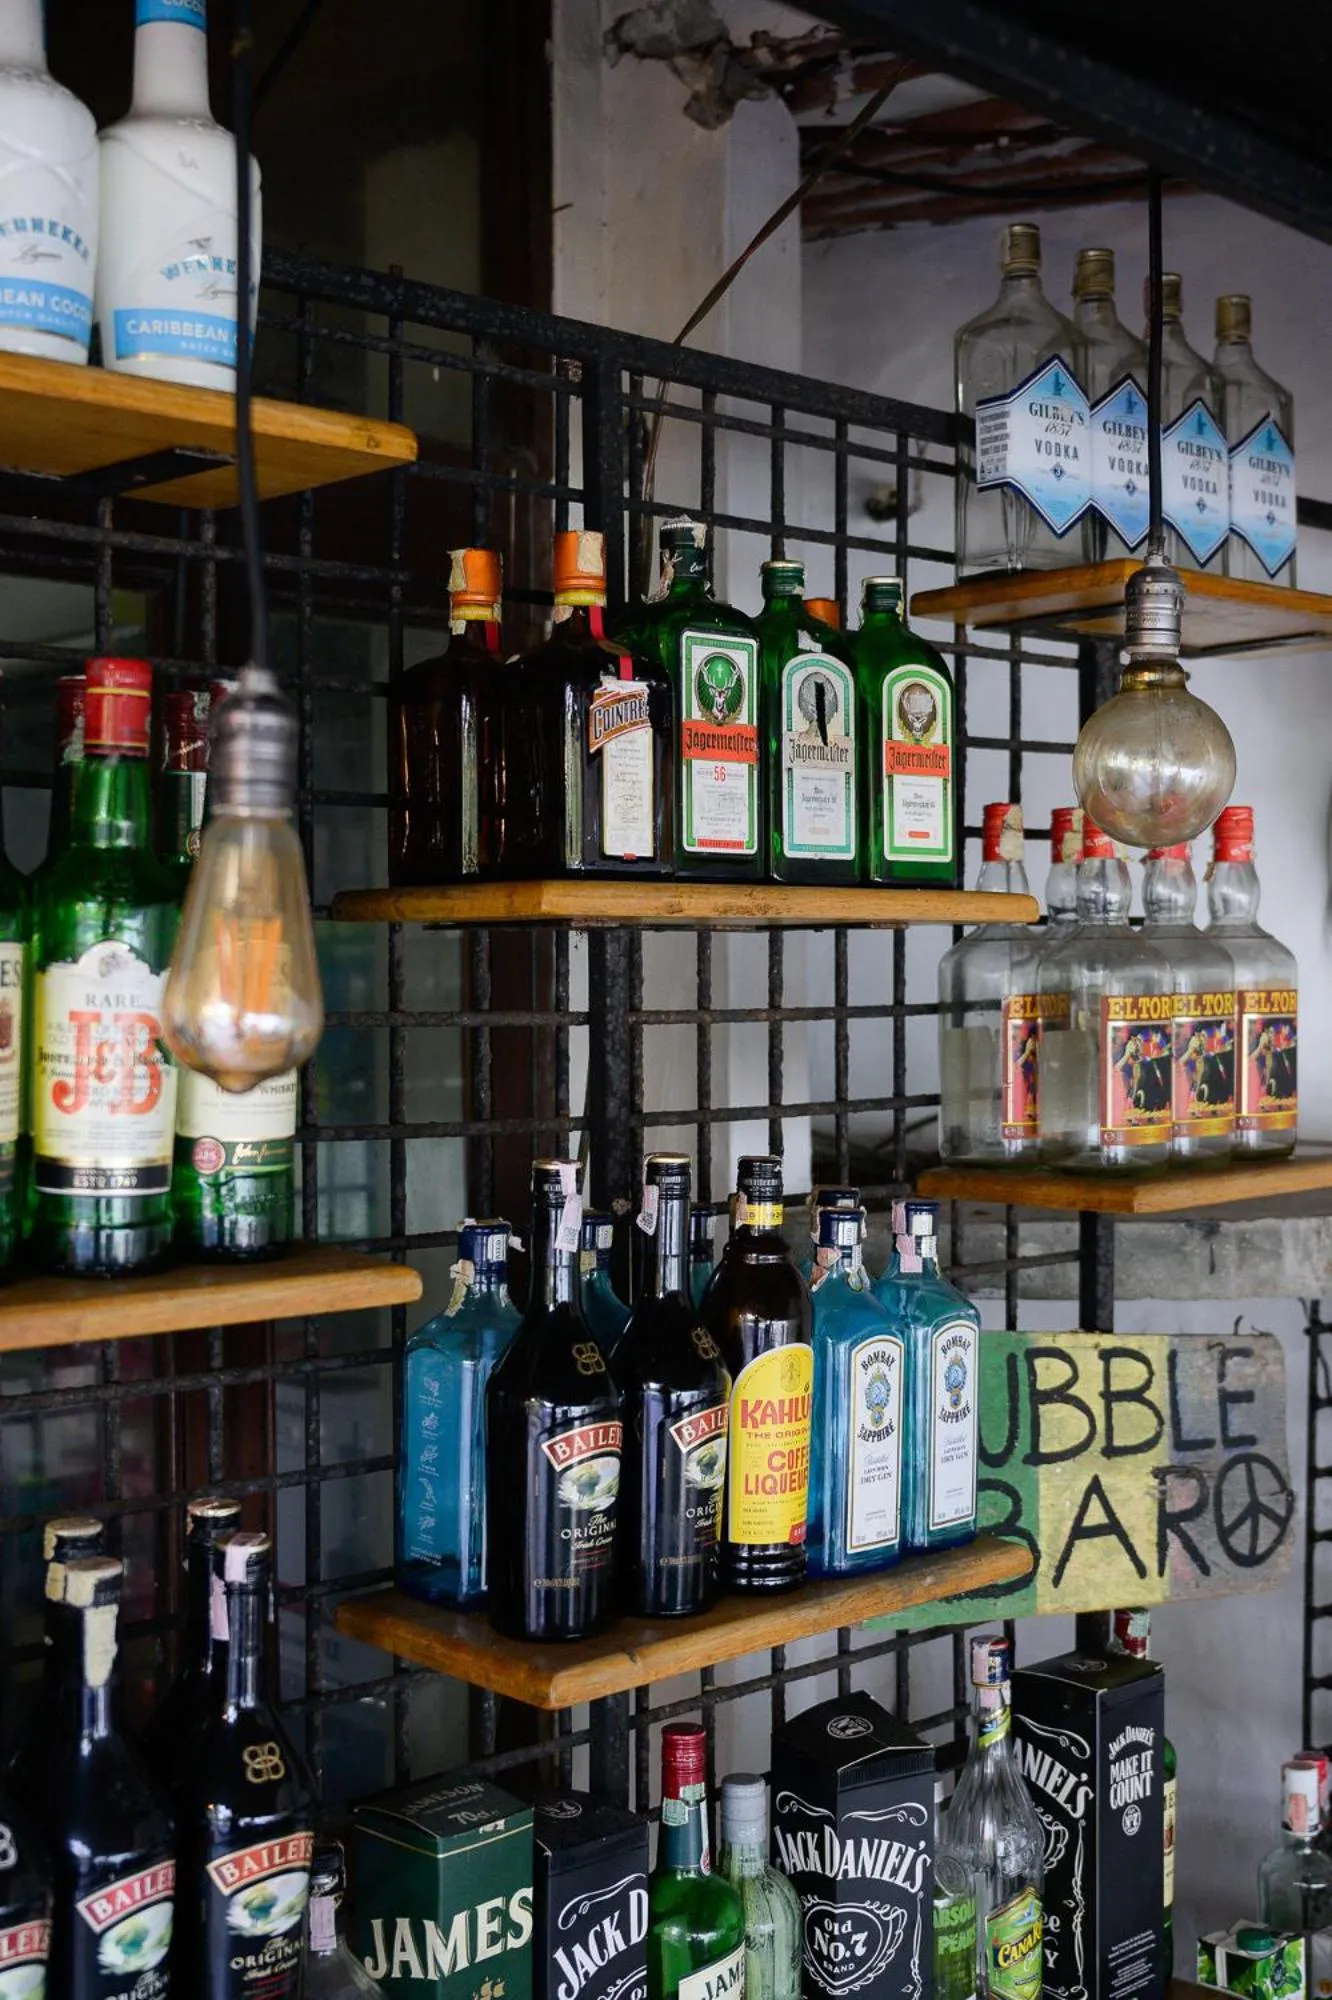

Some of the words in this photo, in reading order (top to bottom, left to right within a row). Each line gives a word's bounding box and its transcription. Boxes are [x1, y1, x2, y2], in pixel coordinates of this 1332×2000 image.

[0, 287, 45, 308] EAN
[126, 319, 229, 342] CARIBBEAN
[1102, 419, 1146, 441] GILBEY
[1034, 438, 1079, 460] VODKA
[1108, 456, 1149, 477] VODKA
[1181, 474, 1218, 495] VODKA
[713, 766, 727, 782] 56
[0, 959, 21, 988] ES
[85, 993, 142, 1009] RARE
[1108, 996, 1137, 1020] EL
[1172, 994, 1200, 1017] EL
[1244, 991, 1271, 1014] EL
[941, 1335, 972, 1359] BOMBAY
[861, 1350, 897, 1375] BOMBAY
[938, 1399, 971, 1424] SAPPHIRE
[977, 1345, 1258, 1467] UBBLE
[681, 1404, 730, 1442] BAIL
[857, 1417, 895, 1443] SAPPHIRE
[747, 1431, 772, 1440] THE
[767, 1444, 809, 1473] COFF
[1108, 1731, 1128, 1761] JACK
[1011, 1736, 1095, 1819] ANIEL'S
[1110, 1754, 1140, 1785] MAKE
[1140, 1750, 1154, 1773] IT
[1110, 1770, 1154, 1810] COUNT
[774, 1825, 823, 1876] JACK
[823, 1824, 932, 1894] DANIEL'S
[824, 1918, 852, 1936] Old
[552, 1910, 628, 2000] JACK
[629, 1888, 649, 1946] D
[823, 1960, 856, 1975] BRAND
